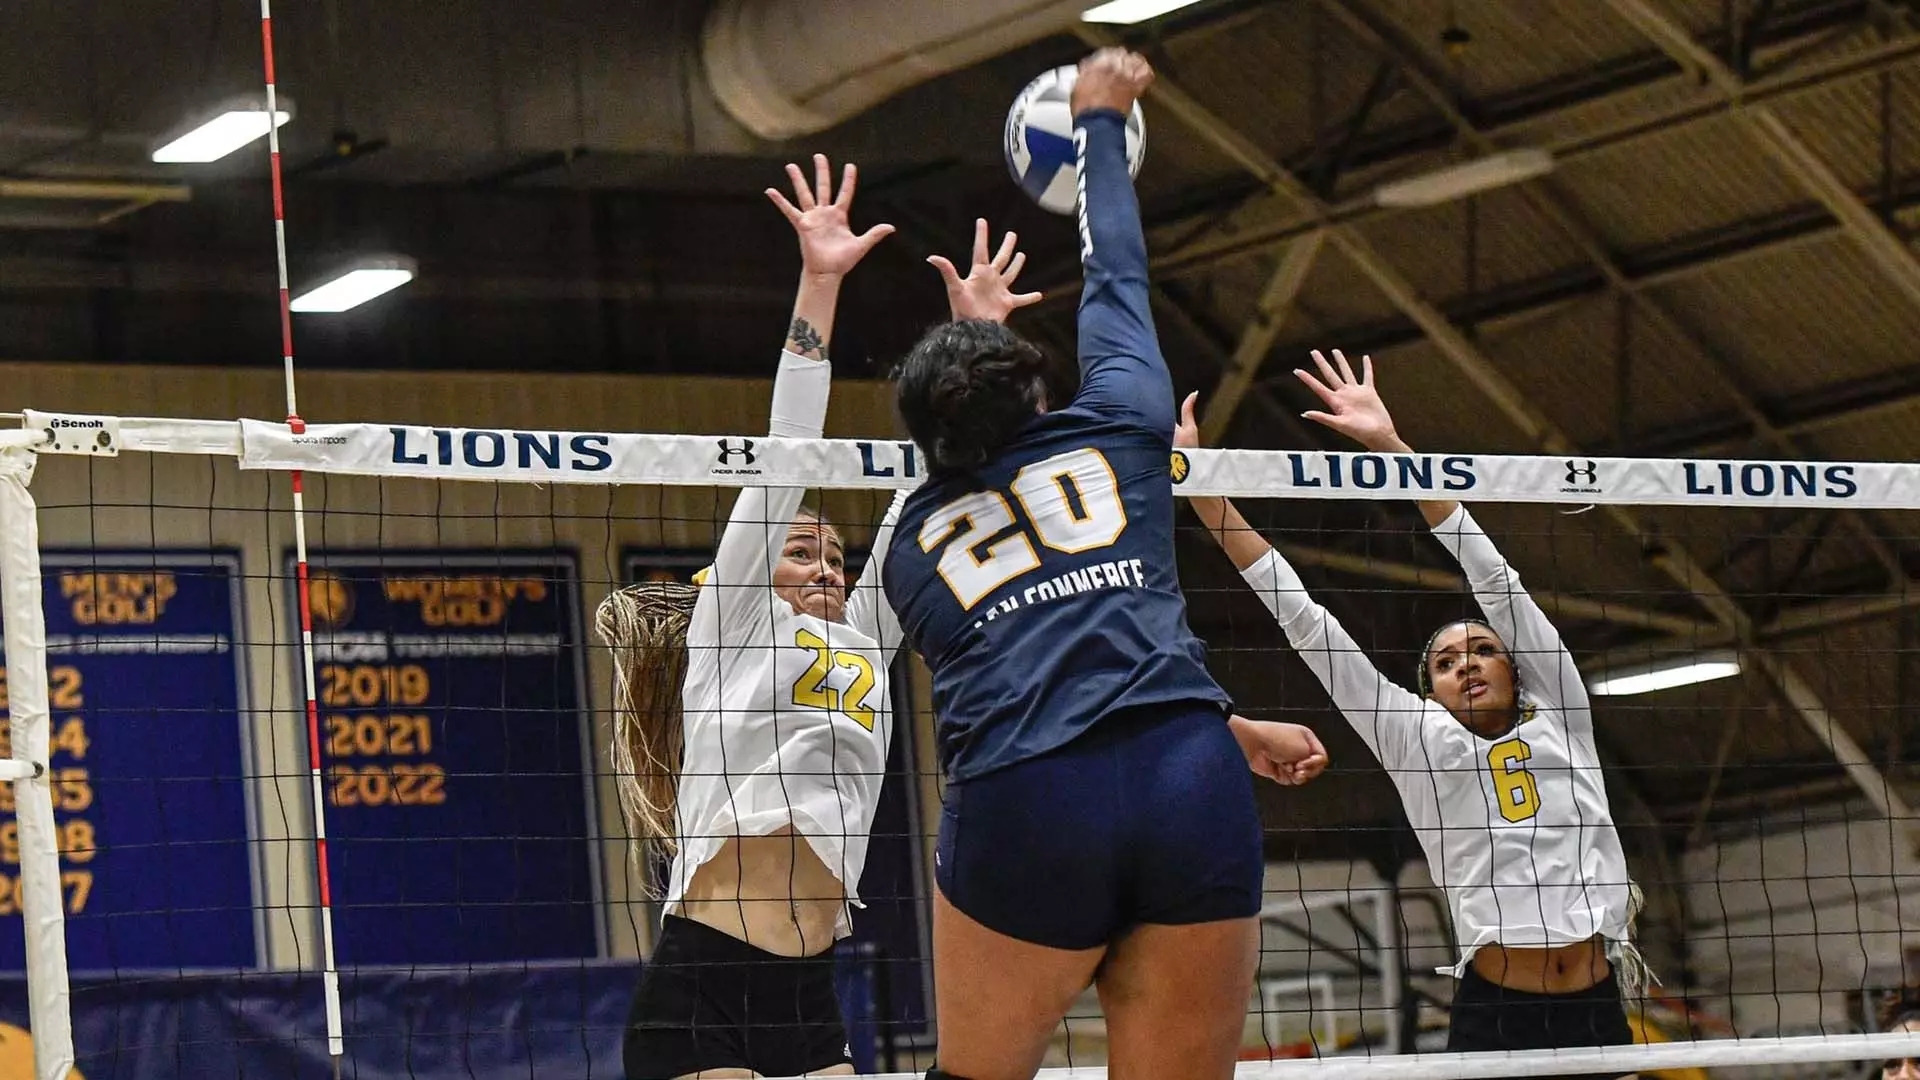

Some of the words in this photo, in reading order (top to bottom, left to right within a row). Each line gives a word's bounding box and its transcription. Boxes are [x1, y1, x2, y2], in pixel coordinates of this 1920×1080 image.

[389, 427, 613, 472] LIONS
[1288, 454, 1476, 490] LIONS
[1683, 463, 1857, 498] LIONS
[918, 447, 1129, 611] 20
[320, 664, 429, 705] 2019
[791, 627, 876, 733] 22
[324, 714, 432, 756] 2021
[329, 763, 447, 806] 2022
[1486, 737, 1541, 823] 6
